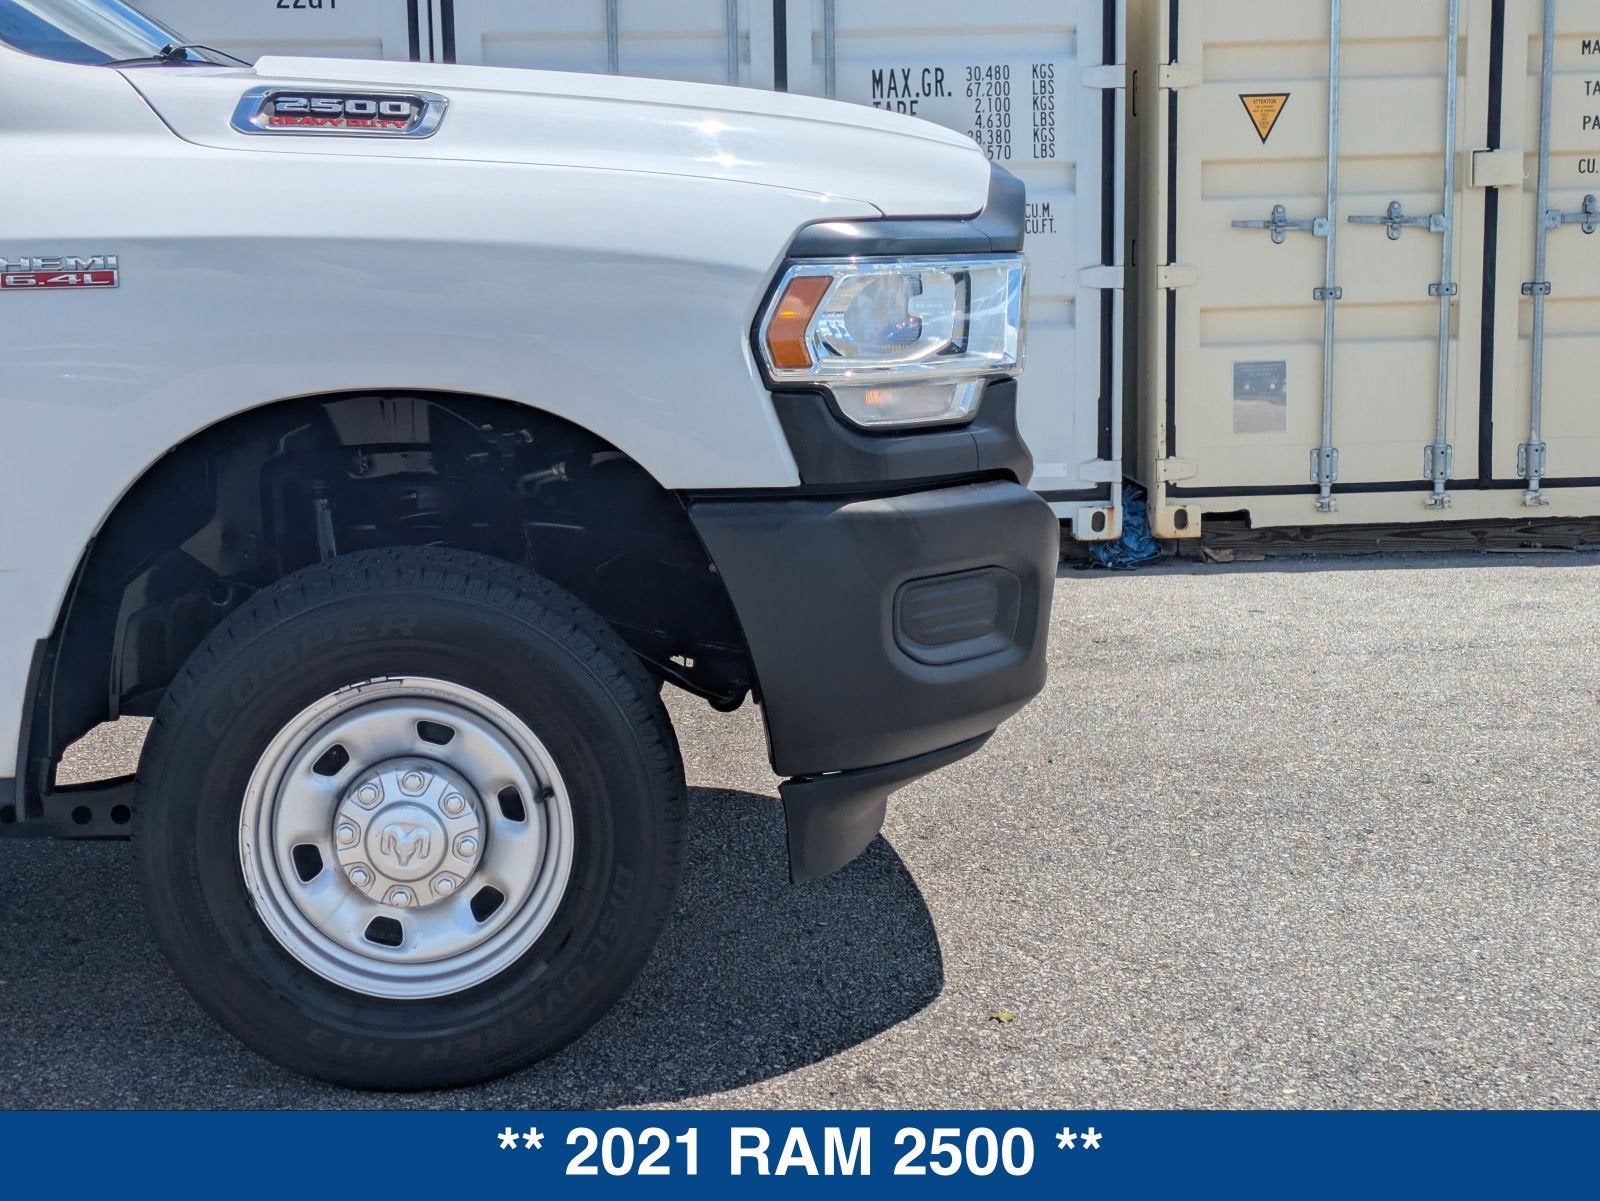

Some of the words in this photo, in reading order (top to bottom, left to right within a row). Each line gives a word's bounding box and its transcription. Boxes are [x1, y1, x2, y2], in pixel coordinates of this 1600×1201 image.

[871, 67, 952, 99] MAX.GR.
[966, 64, 1010, 82] 30.480
[1032, 63, 1055, 80] KGS
[966, 81, 1010, 98] 67.200
[1032, 80, 1055, 96] LBS
[275, 97, 410, 119] 2500
[975, 97, 1011, 113] 2.100
[1032, 96, 1055, 112] KGS
[269, 116, 342, 127] HEAVY
[346, 119, 407, 128] DUTY
[975, 112, 1011, 129] 4.630
[1032, 112, 1055, 127] LBS
[1033, 127, 1055, 143] KGS
[1033, 143, 1056, 159] LBS
[0, 255, 118, 272] HEMI
[5, 273, 111, 286] 6.4L
